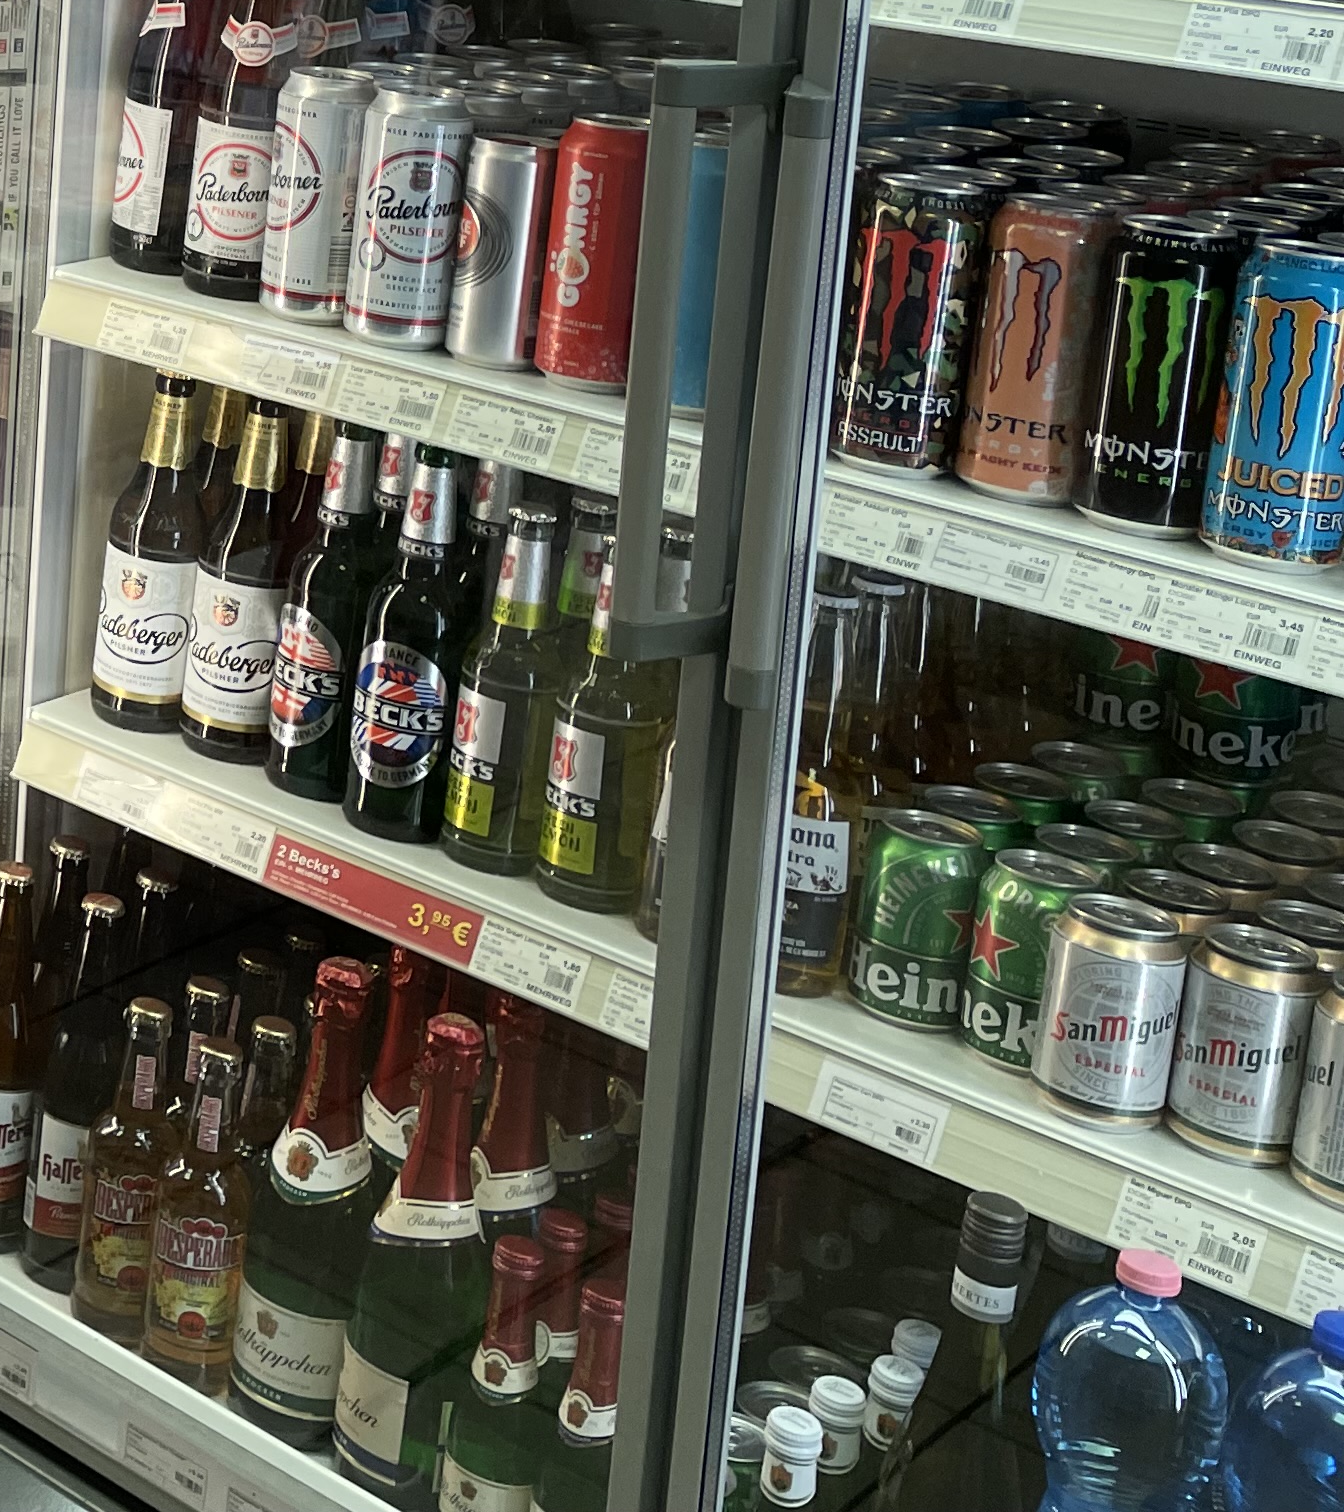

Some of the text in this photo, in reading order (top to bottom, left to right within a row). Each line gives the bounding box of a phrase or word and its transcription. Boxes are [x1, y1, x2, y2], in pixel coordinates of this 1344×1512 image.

[953, 19, 997, 31] EINWEG
[1261, 62, 1311, 77] EINWEG
[10, 97, 24, 173] CALL LOVE
[212, 206, 258, 220] PILSENER
[389, 224, 444, 237] PILSENER
[285, 386, 317, 400] EINWEG
[389, 417, 422, 431] EINWEG
[837, 420, 922, 453] ASSAULT
[503, 449, 538, 465] EINWEG
[109, 639, 147, 656] PILSNER
[1233, 649, 1282, 671] EINWEG
[201, 667, 240, 684] PILSNER
[355, 696, 444, 731] BECK'S
[277, 845, 342, 880] 2 Becks's
[526, 983, 572, 1007] MEHRWEG
[1075, 1053, 1146, 1077] ESPECIAL
[1189, 1074, 1257, 1107] ESPECIAL
[1188, 1259, 1234, 1285] EINWEG
